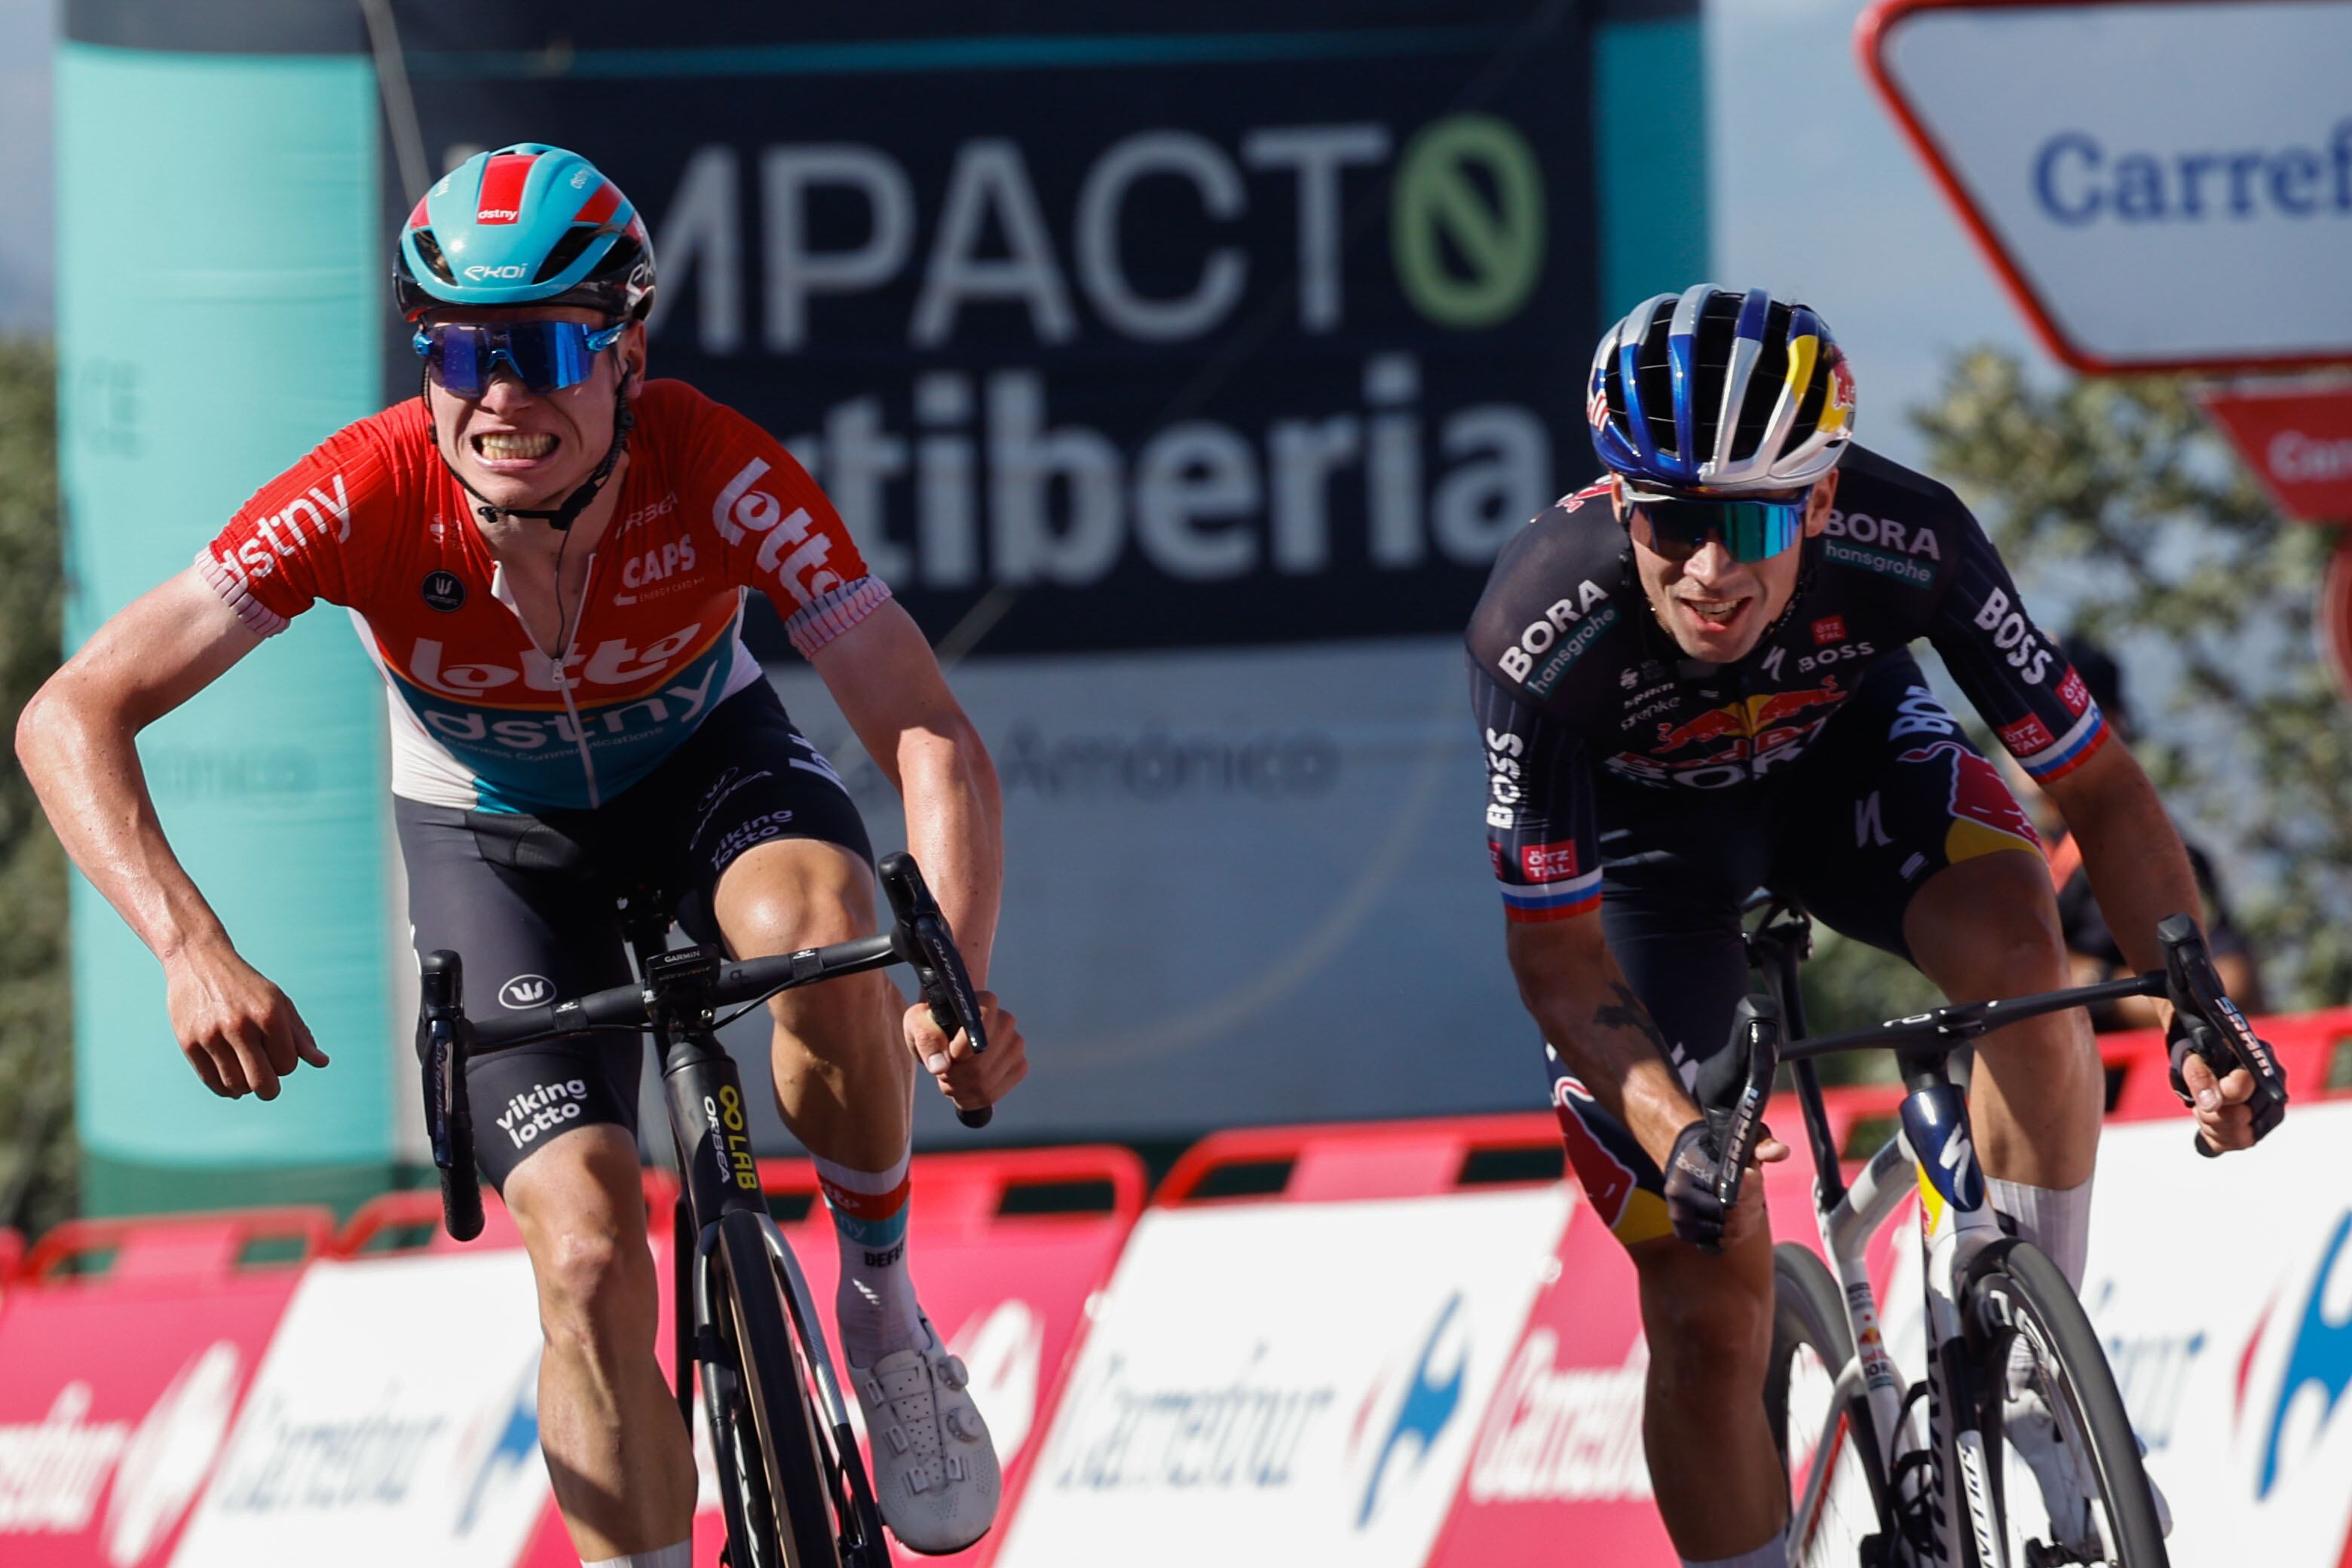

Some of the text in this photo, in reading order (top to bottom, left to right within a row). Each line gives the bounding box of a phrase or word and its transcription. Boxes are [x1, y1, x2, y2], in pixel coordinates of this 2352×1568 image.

[478, 210, 518, 223] dstny
[623, 532, 696, 590] CAPS
[1823, 509, 1941, 561] BORA
[1825, 541, 1931, 583] hansgrohe
[1498, 579, 1609, 684] BORA
[1527, 608, 1616, 694] hansgrohe
[1798, 642, 1876, 673] BOSS
[1974, 586, 2053, 685] BOSS
[409, 623, 702, 698] lotto
[423, 658, 719, 749] dstny
[1485, 727, 1524, 830] BOSS
[1527, 849, 1570, 865] ÖTZ
[1528, 863, 1572, 877] TAL
[663, 950, 701, 963] GARMIN
[495, 1079, 588, 1130] viking
[507, 1102, 581, 1150] lotto
[703, 1095, 730, 1184] ORBEA
